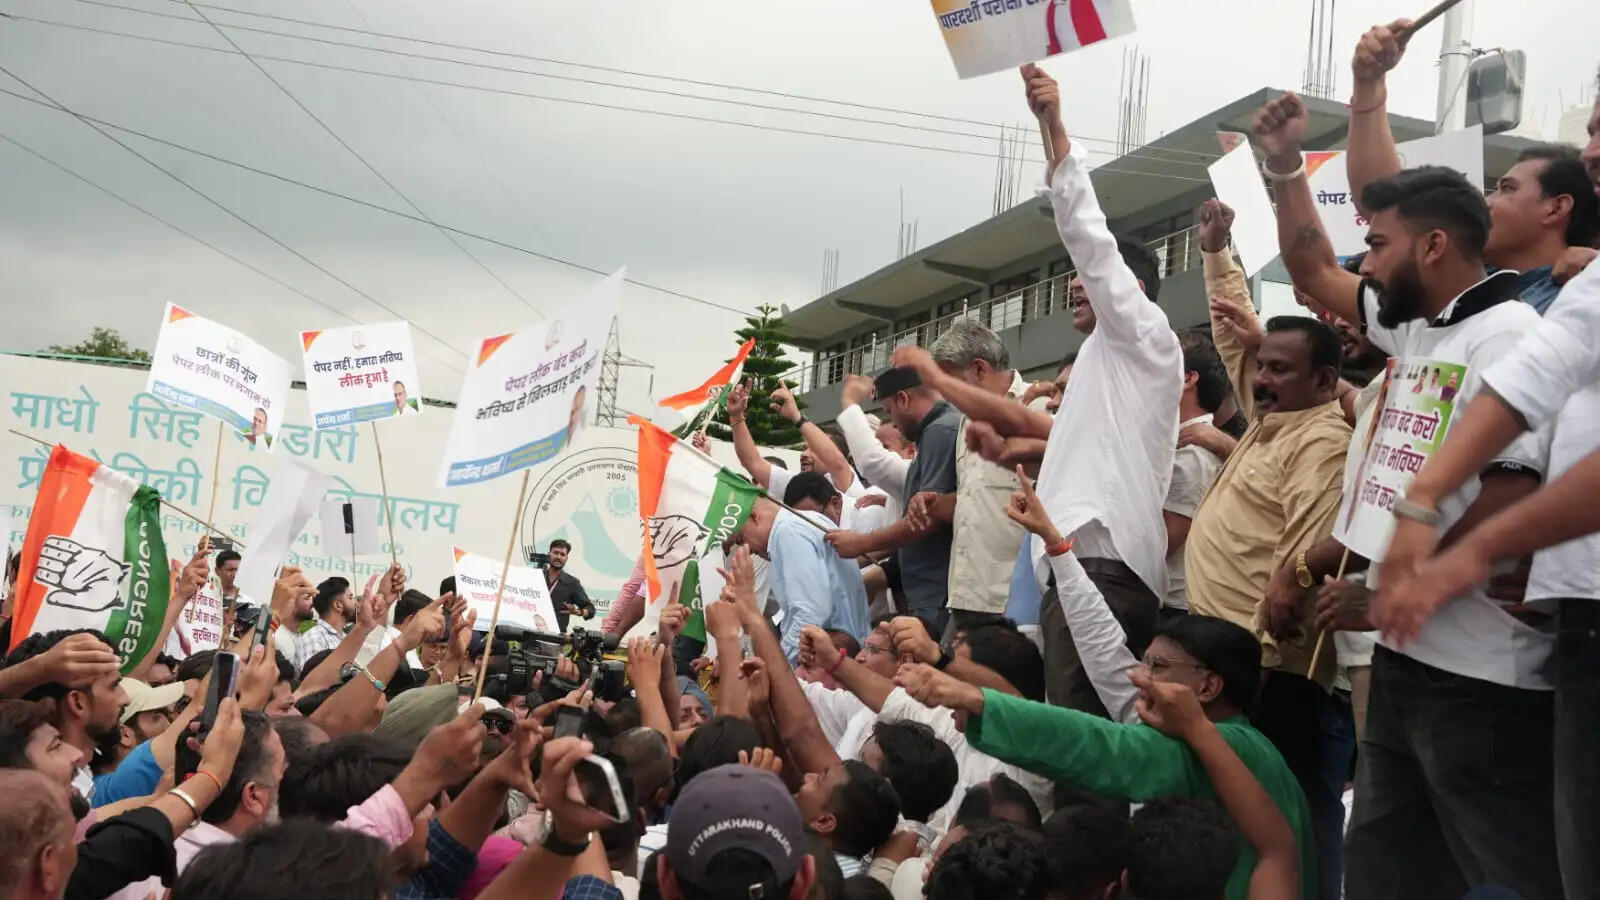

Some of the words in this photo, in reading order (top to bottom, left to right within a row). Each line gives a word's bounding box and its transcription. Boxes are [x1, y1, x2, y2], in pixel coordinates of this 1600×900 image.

[939, 6, 982, 29] पारदर्शी
[1317, 190, 1347, 205] पेपर
[225, 357, 242, 373] की
[313, 361, 332, 373] पेपर
[379, 350, 403, 364] भविष्य
[338, 373, 364, 388] लीक
[364, 371, 382, 388] हुआ
[10, 385, 101, 434] माधो
[128, 392, 205, 449] सिंह
[1412, 410, 1440, 441] करो
[1388, 443, 1426, 476] भविष्य
[605, 472, 626, 482] 2005
[1378, 487, 1397, 513] कर
[688, 818, 765, 857] UTTARAKHAND
[765, 824, 792, 857] POLICE
